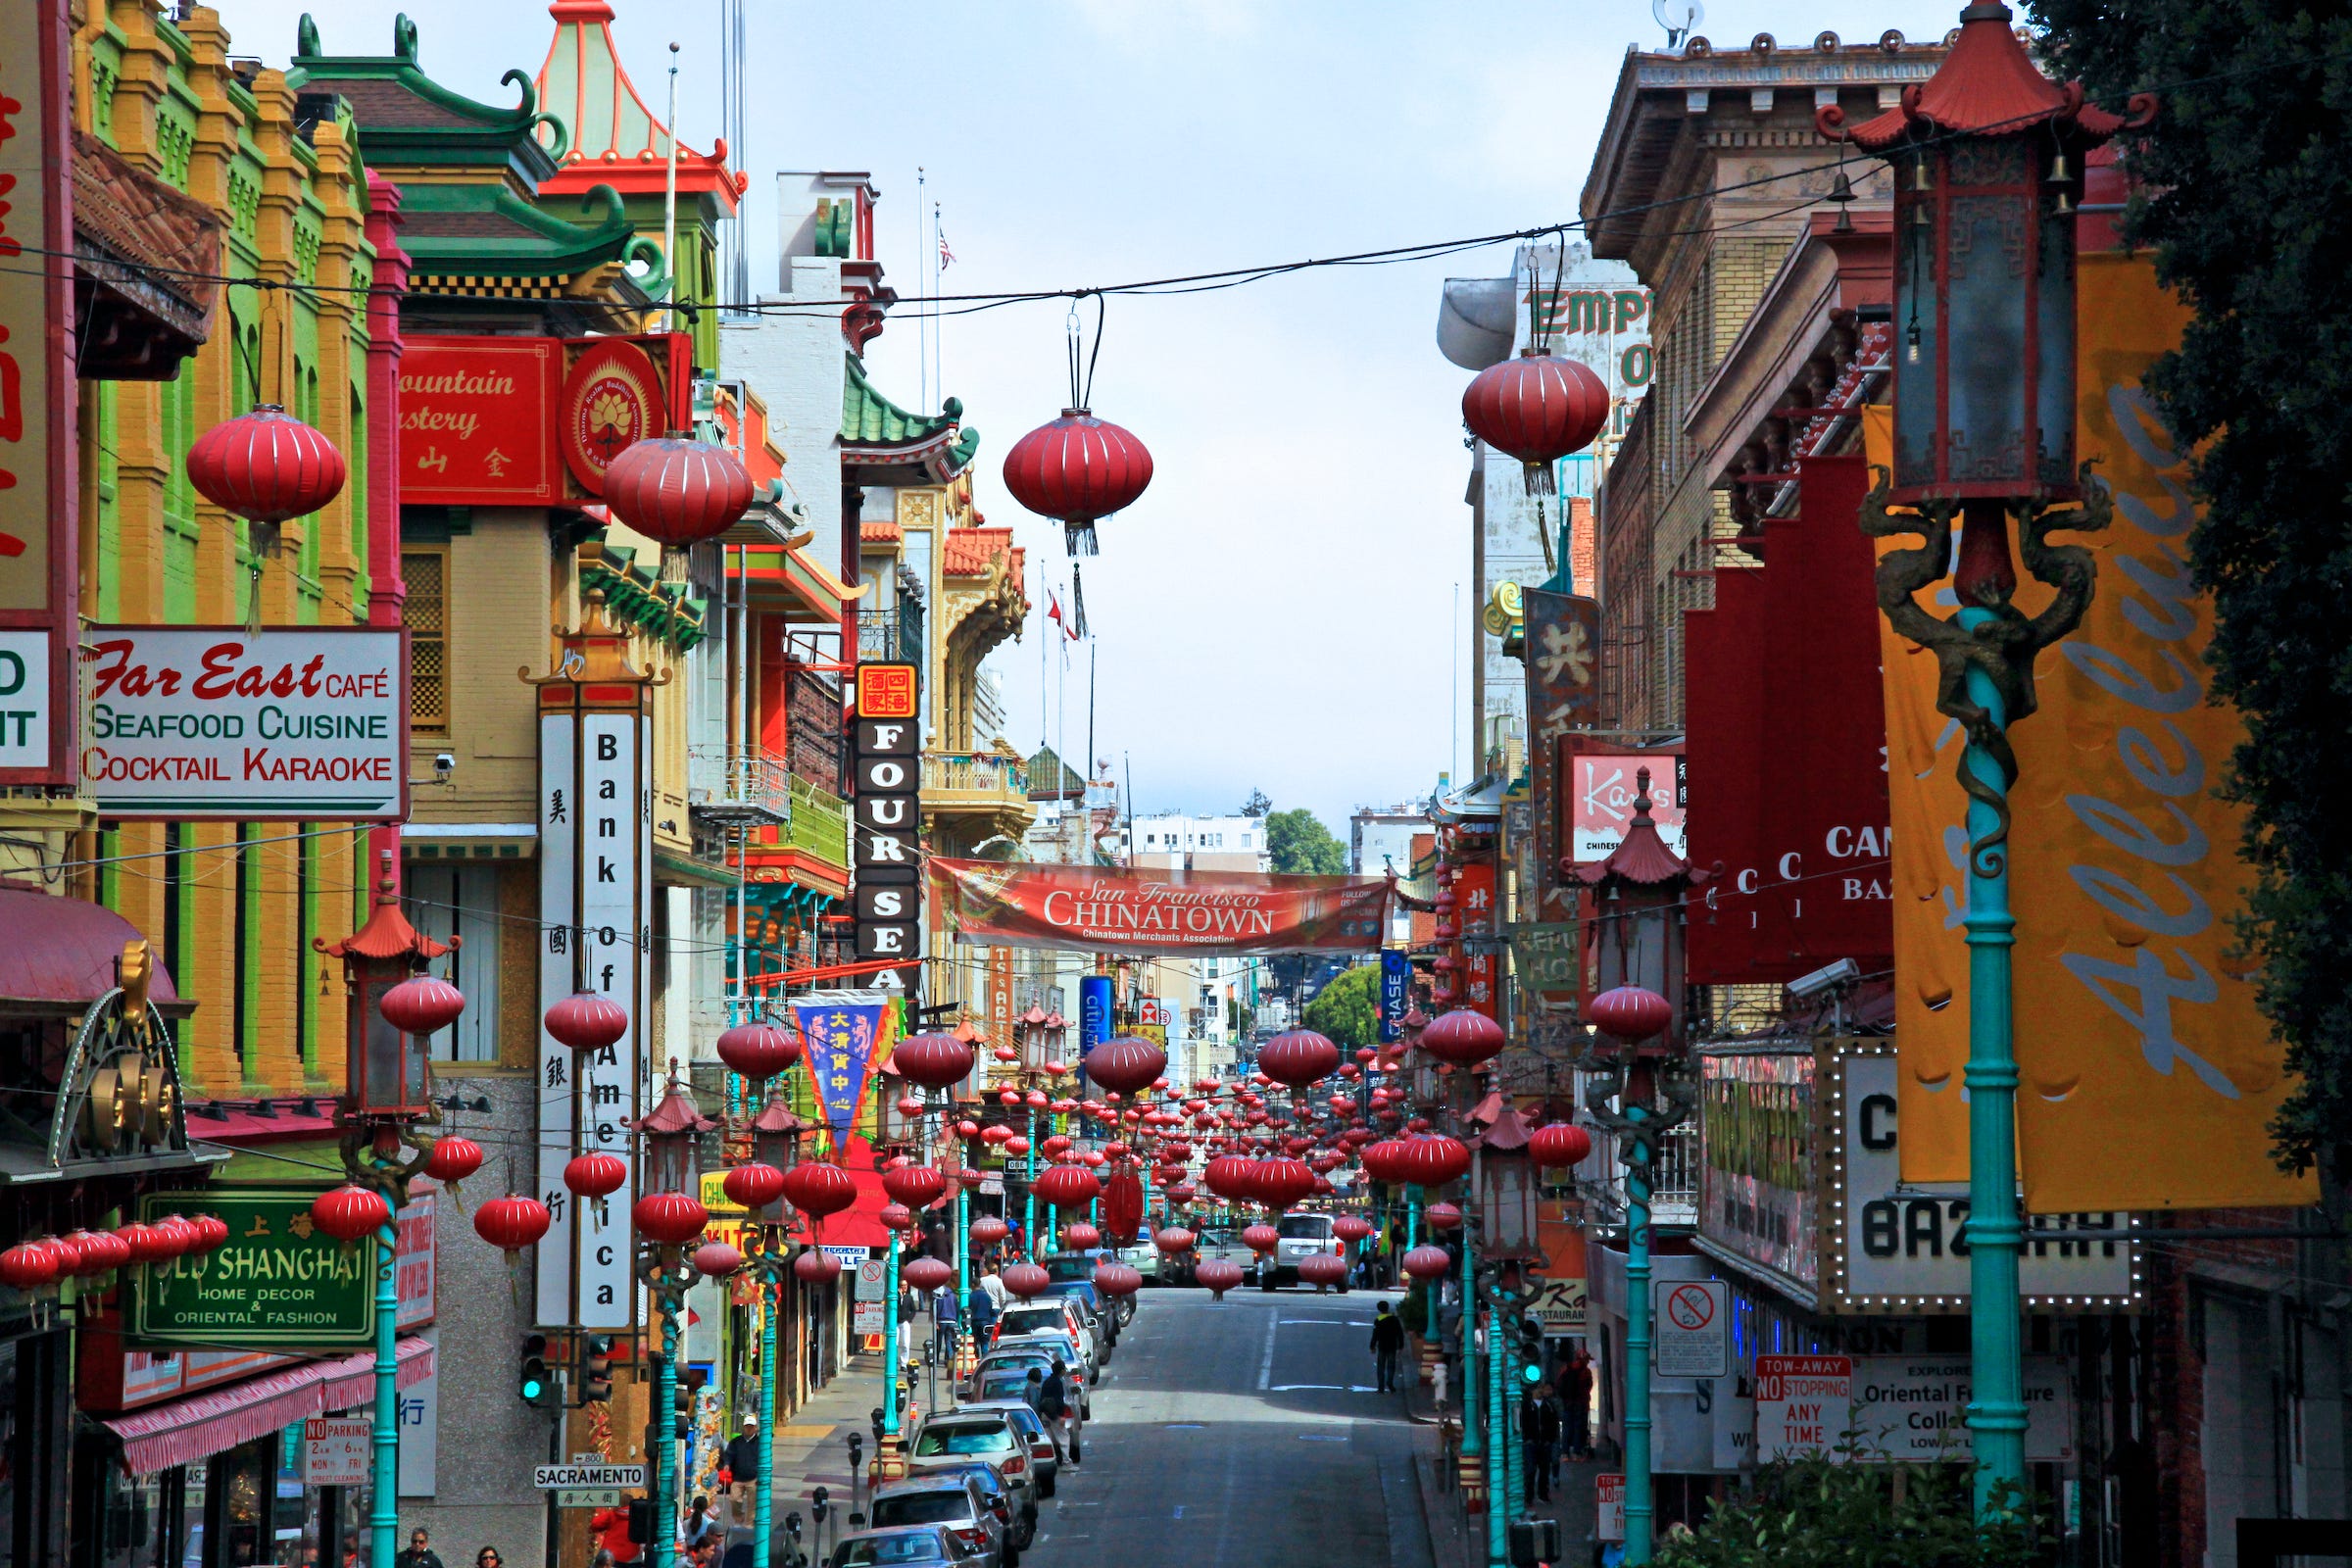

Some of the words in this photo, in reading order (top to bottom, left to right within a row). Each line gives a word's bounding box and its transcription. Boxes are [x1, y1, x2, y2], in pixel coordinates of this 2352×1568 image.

[82, 639, 182, 702] Far
[192, 642, 325, 700] East
[325, 667, 389, 698] CAFÉ
[89, 704, 244, 739] SEAFOOD
[258, 705, 388, 740] CUISINE
[82, 747, 230, 781] COCKTAIL
[244, 748, 392, 781] KARAOKE
[870, 725, 906, 861] FOUR
[598, 734, 617, 883] Bank
[1079, 879, 1126, 903] San
[1134, 882, 1261, 907] Francisco
[1044, 890, 1274, 935] CHINATOWN
[1083, 929, 1130, 940] Chinatown
[1133, 931, 1180, 943] Merchants
[1183, 933, 1235, 944] Association
[599, 926, 616, 992] of
[1389, 974, 1401, 1036] CHASE
[596, 1045, 619, 1305] Ameica
[707, 1229, 761, 1252] KIT
[218, 1248, 362, 1282] SHANGHAI
[198, 1289, 247, 1300] HOME
[257, 1289, 316, 1300] DECOR
[251, 1300, 262, 1311] &
[174, 1311, 256, 1323] ORIENTAL
[267, 1311, 337, 1323] FASHION
[1765, 1360, 1841, 1372] TOW-AWAY
[1757, 1378, 1782, 1400] NO
[1784, 1380, 1848, 1396] STOPPING
[1865, 1384, 1949, 1402] Oriental
[1787, 1404, 1821, 1421] ANY
[307, 1421, 324, 1439] NO
[328, 1425, 368, 1437] PARKING
[1784, 1426, 1824, 1444] TIME
[312, 1442, 318, 1454] 2
[345, 1442, 351, 1453] 6
[312, 1458, 327, 1469] MON
[349, 1458, 361, 1469] FRI
[585, 1454, 602, 1463] 800
[311, 1474, 332, 1483] STREET
[334, 1474, 365, 1483] CLEANING
[536, 1469, 642, 1485] SACRAMENTO
[1598, 1487, 1613, 1501] NO
